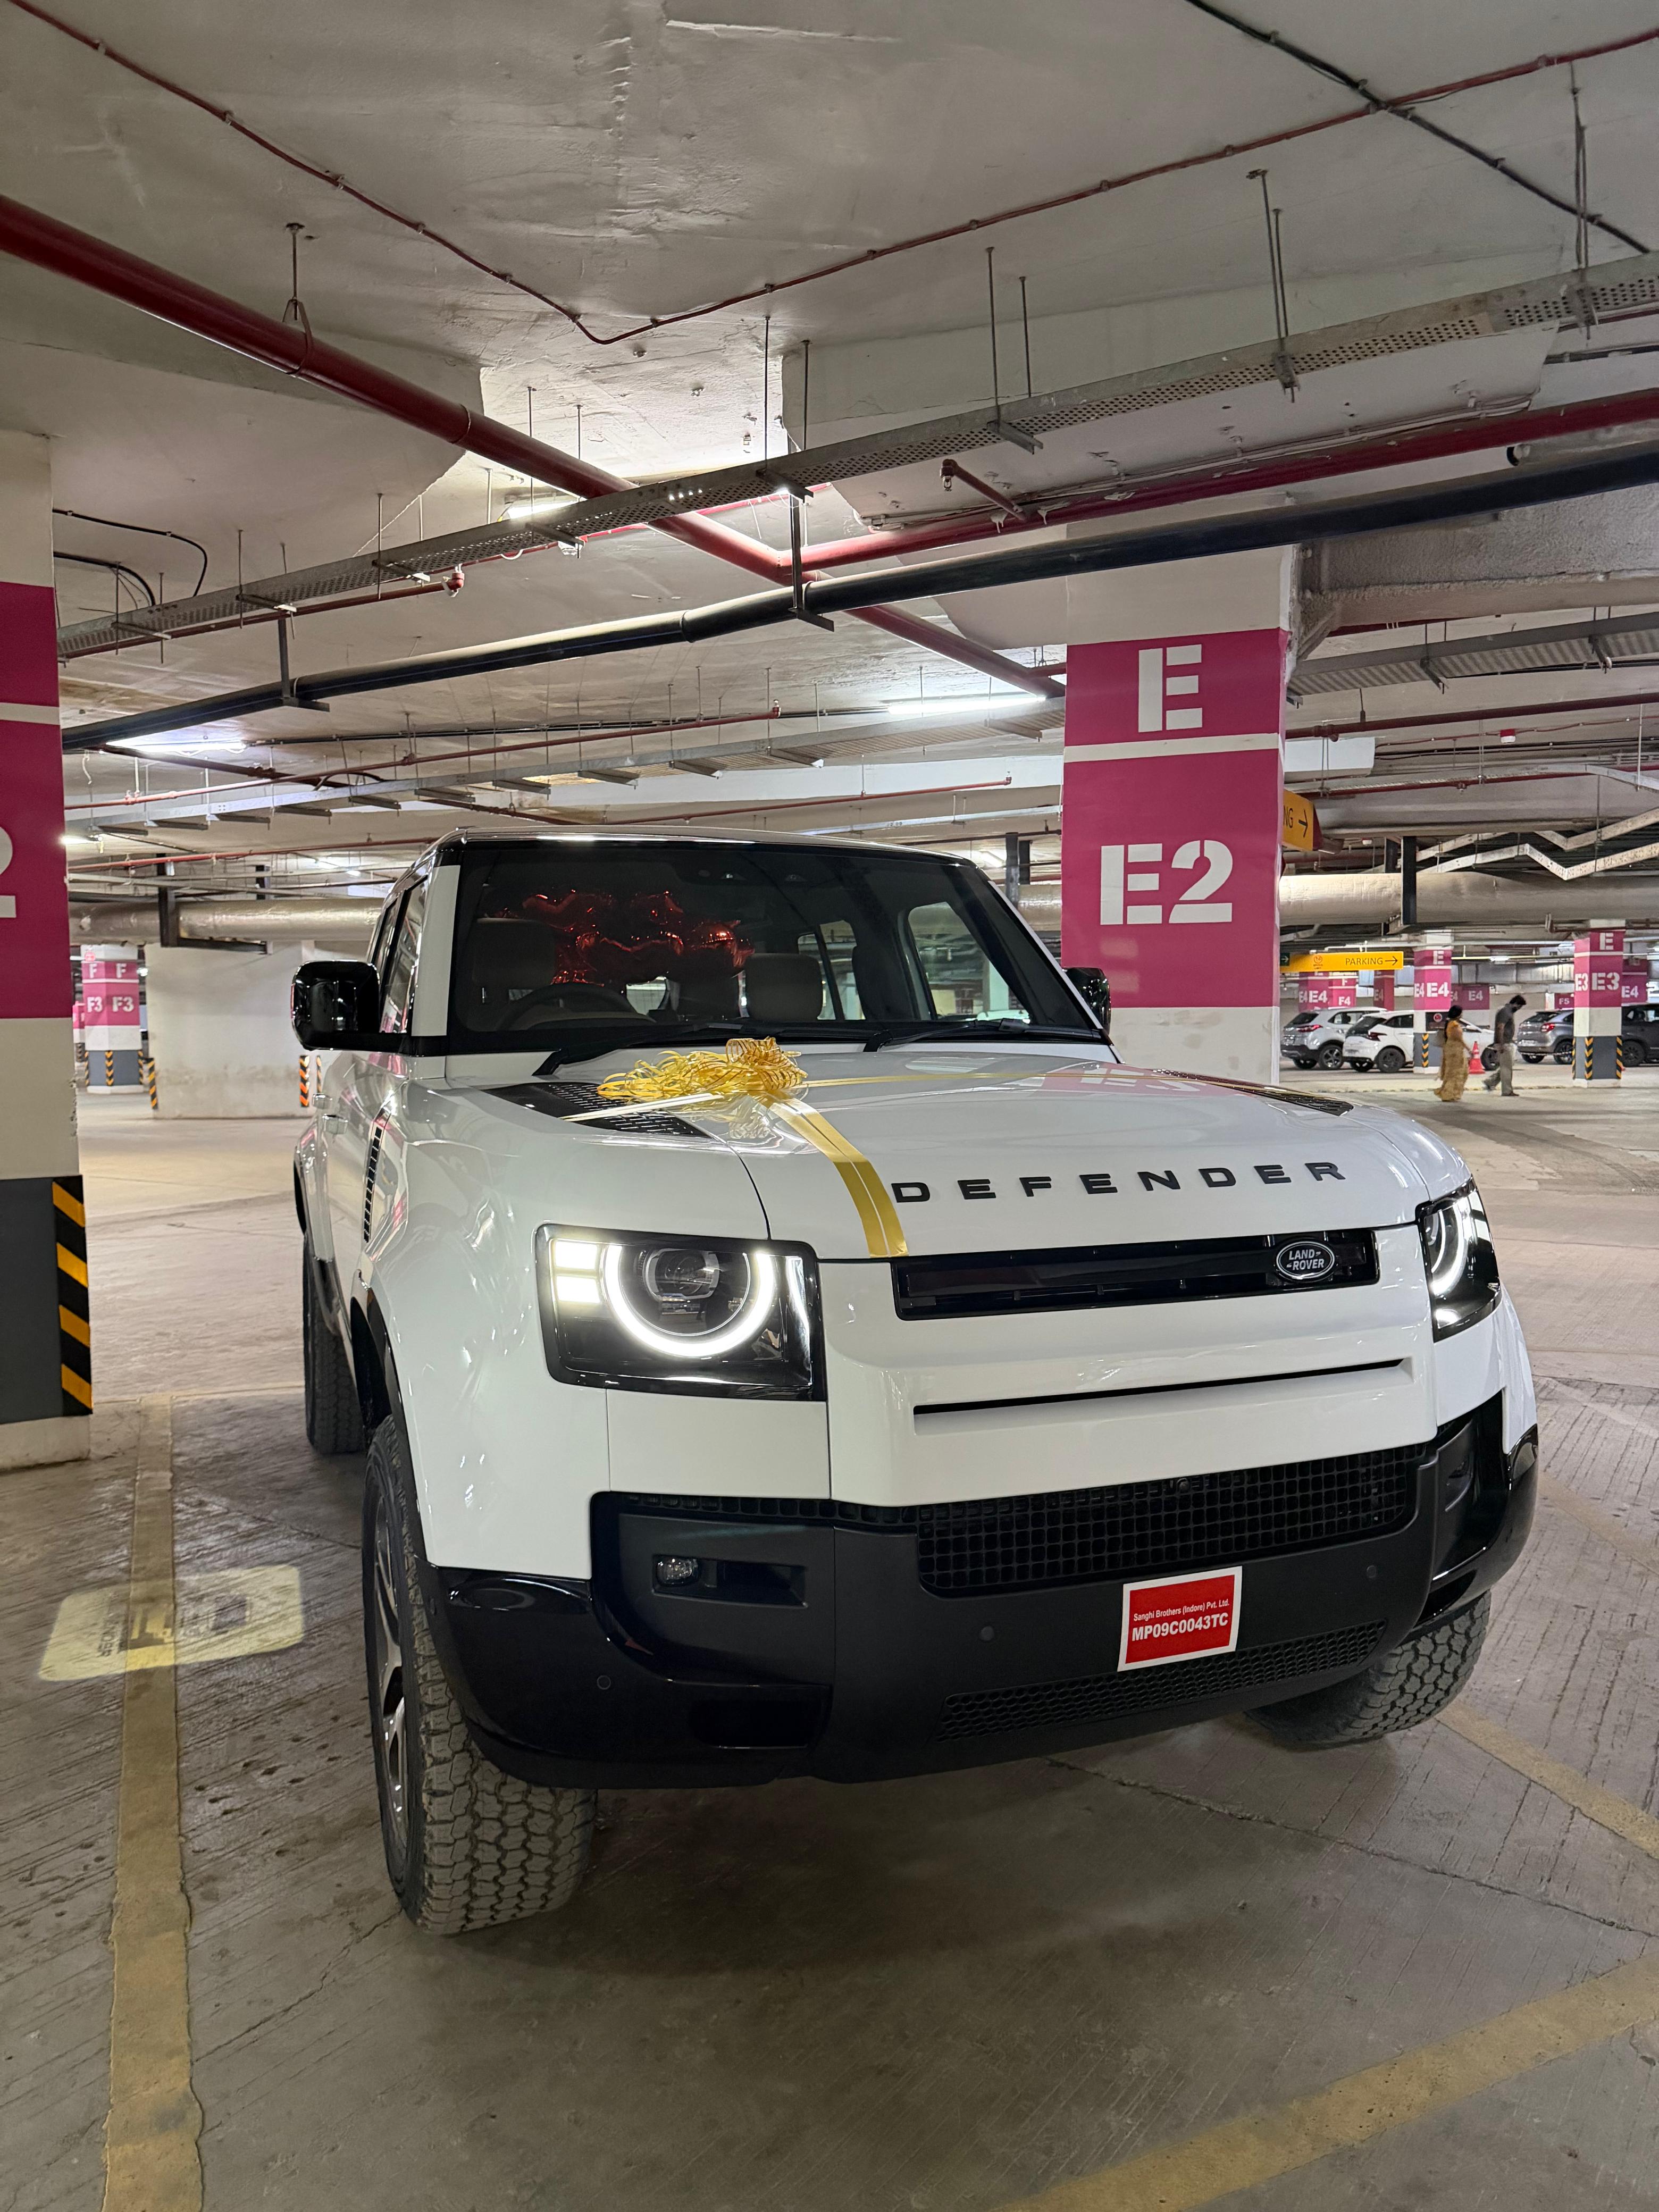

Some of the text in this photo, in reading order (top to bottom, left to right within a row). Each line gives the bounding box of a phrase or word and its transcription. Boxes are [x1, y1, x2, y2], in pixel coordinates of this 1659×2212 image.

[1138, 644, 1202, 733] E
[1100, 840, 1233, 925] E2
[1599, 932, 1614, 950] E
[1345, 957, 1383, 966] PARKING
[1433, 950, 1444, 965] E
[89, 963, 97, 978] F
[116, 963, 127, 978] F
[1574, 973, 1589, 991] E3
[1591, 972, 1620, 991] E3
[1309, 990, 1328, 1003] E4
[1414, 983, 1425, 998] E4
[1426, 982, 1449, 998] E4
[1469, 991, 1484, 1001] E4
[1621, 985, 1639, 998] E4
[87, 996, 103, 1012] F3
[112, 996, 134, 1012] F3
[1338, 996, 1351, 1006] F4
[891, 1162, 1346, 1204] DEFENDER
[1289, 1249, 1315, 1260] LAND
[1293, 1258, 1325, 1270] ROVER
[1133, 1598, 1229, 1622] Sanghi Brothers (Indore) Pvt. Ltd.
[1132, 1612, 1229, 1641] MP09C0043TC
